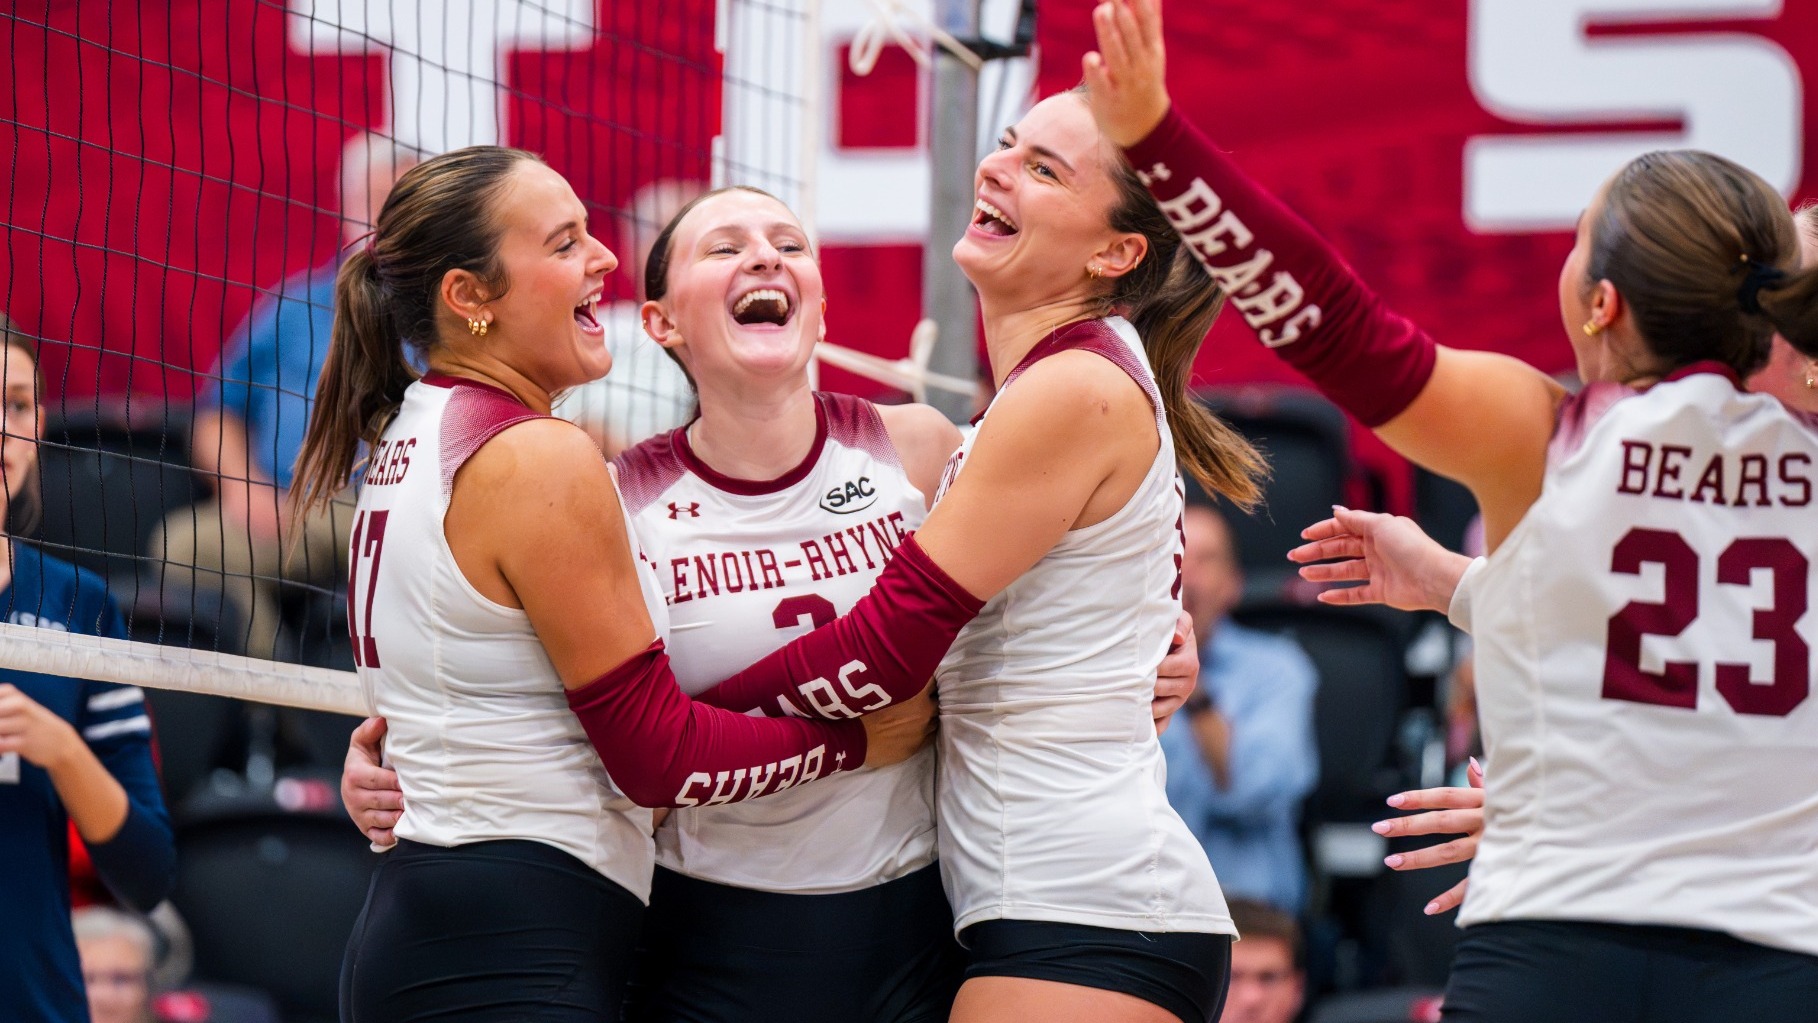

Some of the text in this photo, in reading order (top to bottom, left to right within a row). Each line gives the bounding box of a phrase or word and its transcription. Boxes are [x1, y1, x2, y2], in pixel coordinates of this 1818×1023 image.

[1158, 176, 1322, 348] BEARS
[364, 437, 417, 486] EARS
[826, 476, 876, 507] SAC
[1617, 438, 1812, 507] BEARS
[347, 509, 390, 669] 17
[651, 511, 906, 606] ENOIR-RHYNE
[1601, 526, 1809, 717] 23
